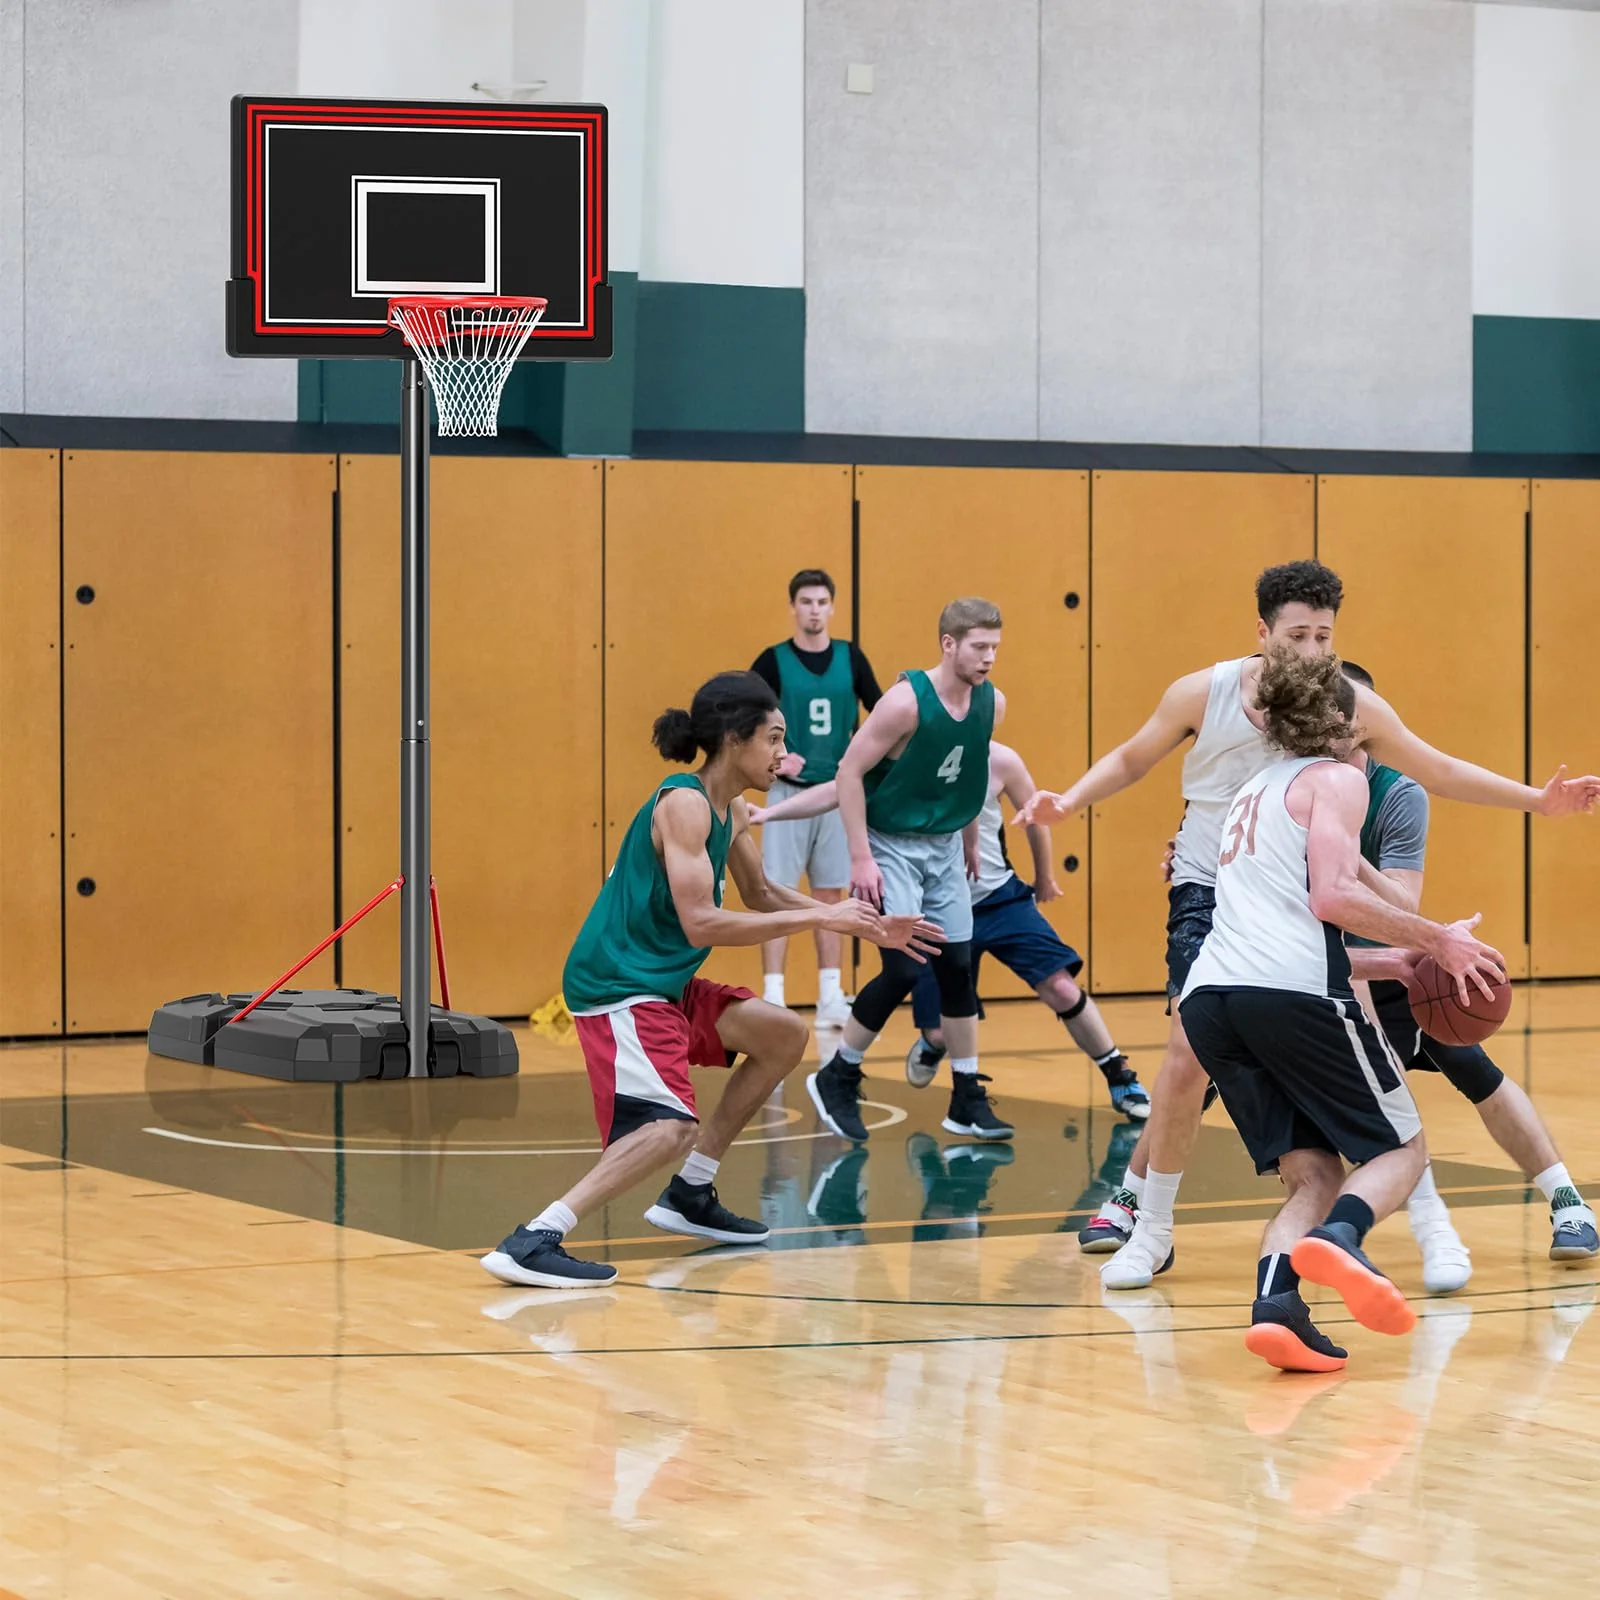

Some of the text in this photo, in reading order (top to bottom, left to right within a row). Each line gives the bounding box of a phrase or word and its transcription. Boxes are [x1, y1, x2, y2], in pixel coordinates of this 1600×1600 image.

[810, 698, 832, 735] 9
[937, 745, 964, 784] 4
[1220, 785, 1267, 866] 31
